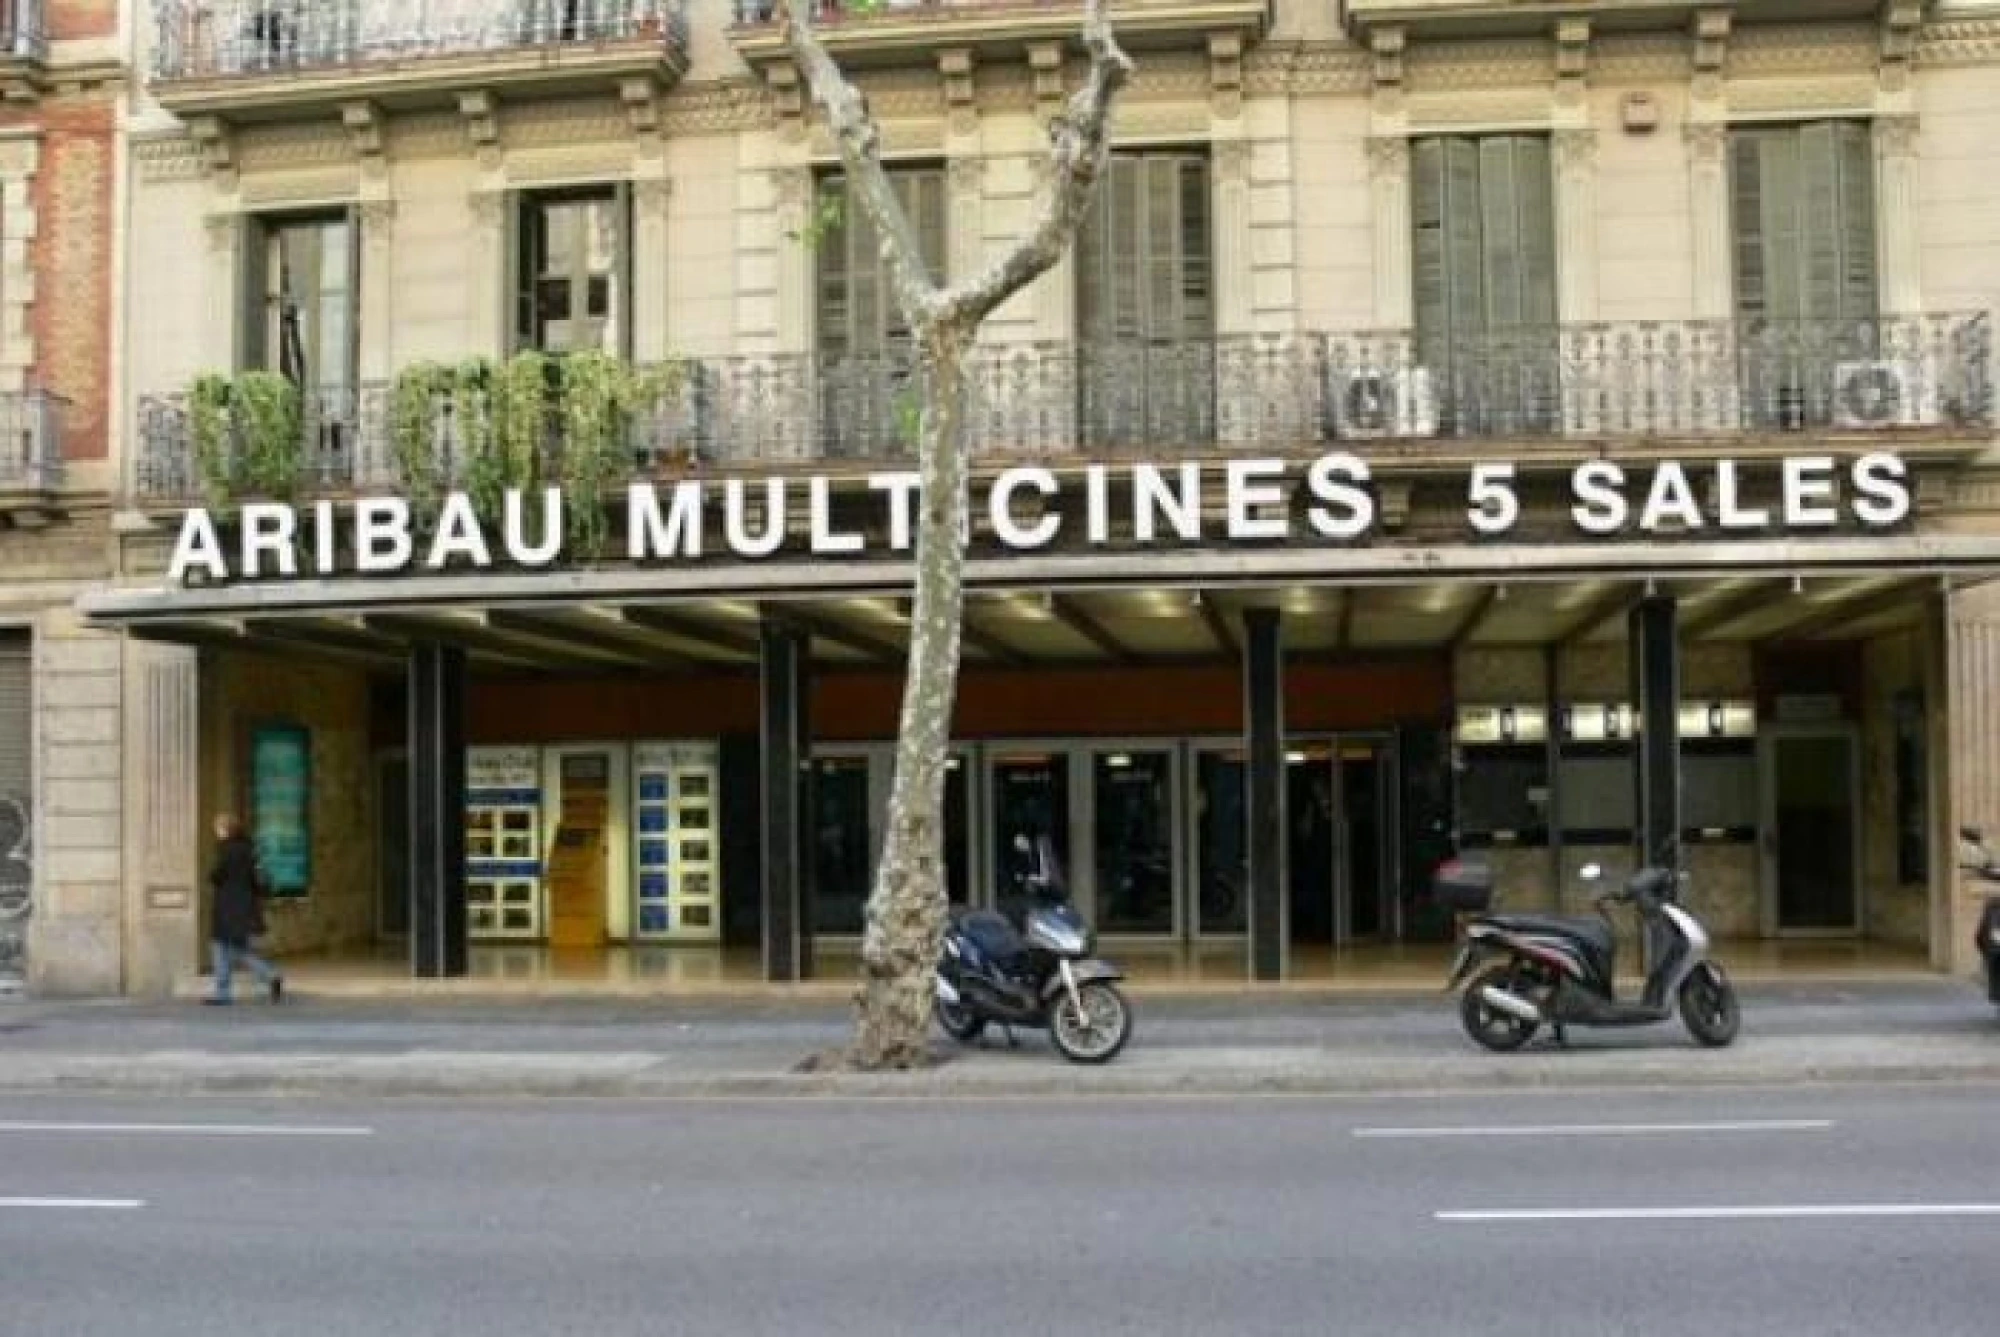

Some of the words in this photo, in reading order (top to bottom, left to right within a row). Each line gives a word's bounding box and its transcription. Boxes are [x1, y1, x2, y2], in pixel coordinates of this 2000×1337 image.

[167, 486, 562, 578] ARIBAU
[1467, 461, 1518, 532] 5
[1570, 452, 1911, 532] SALES
